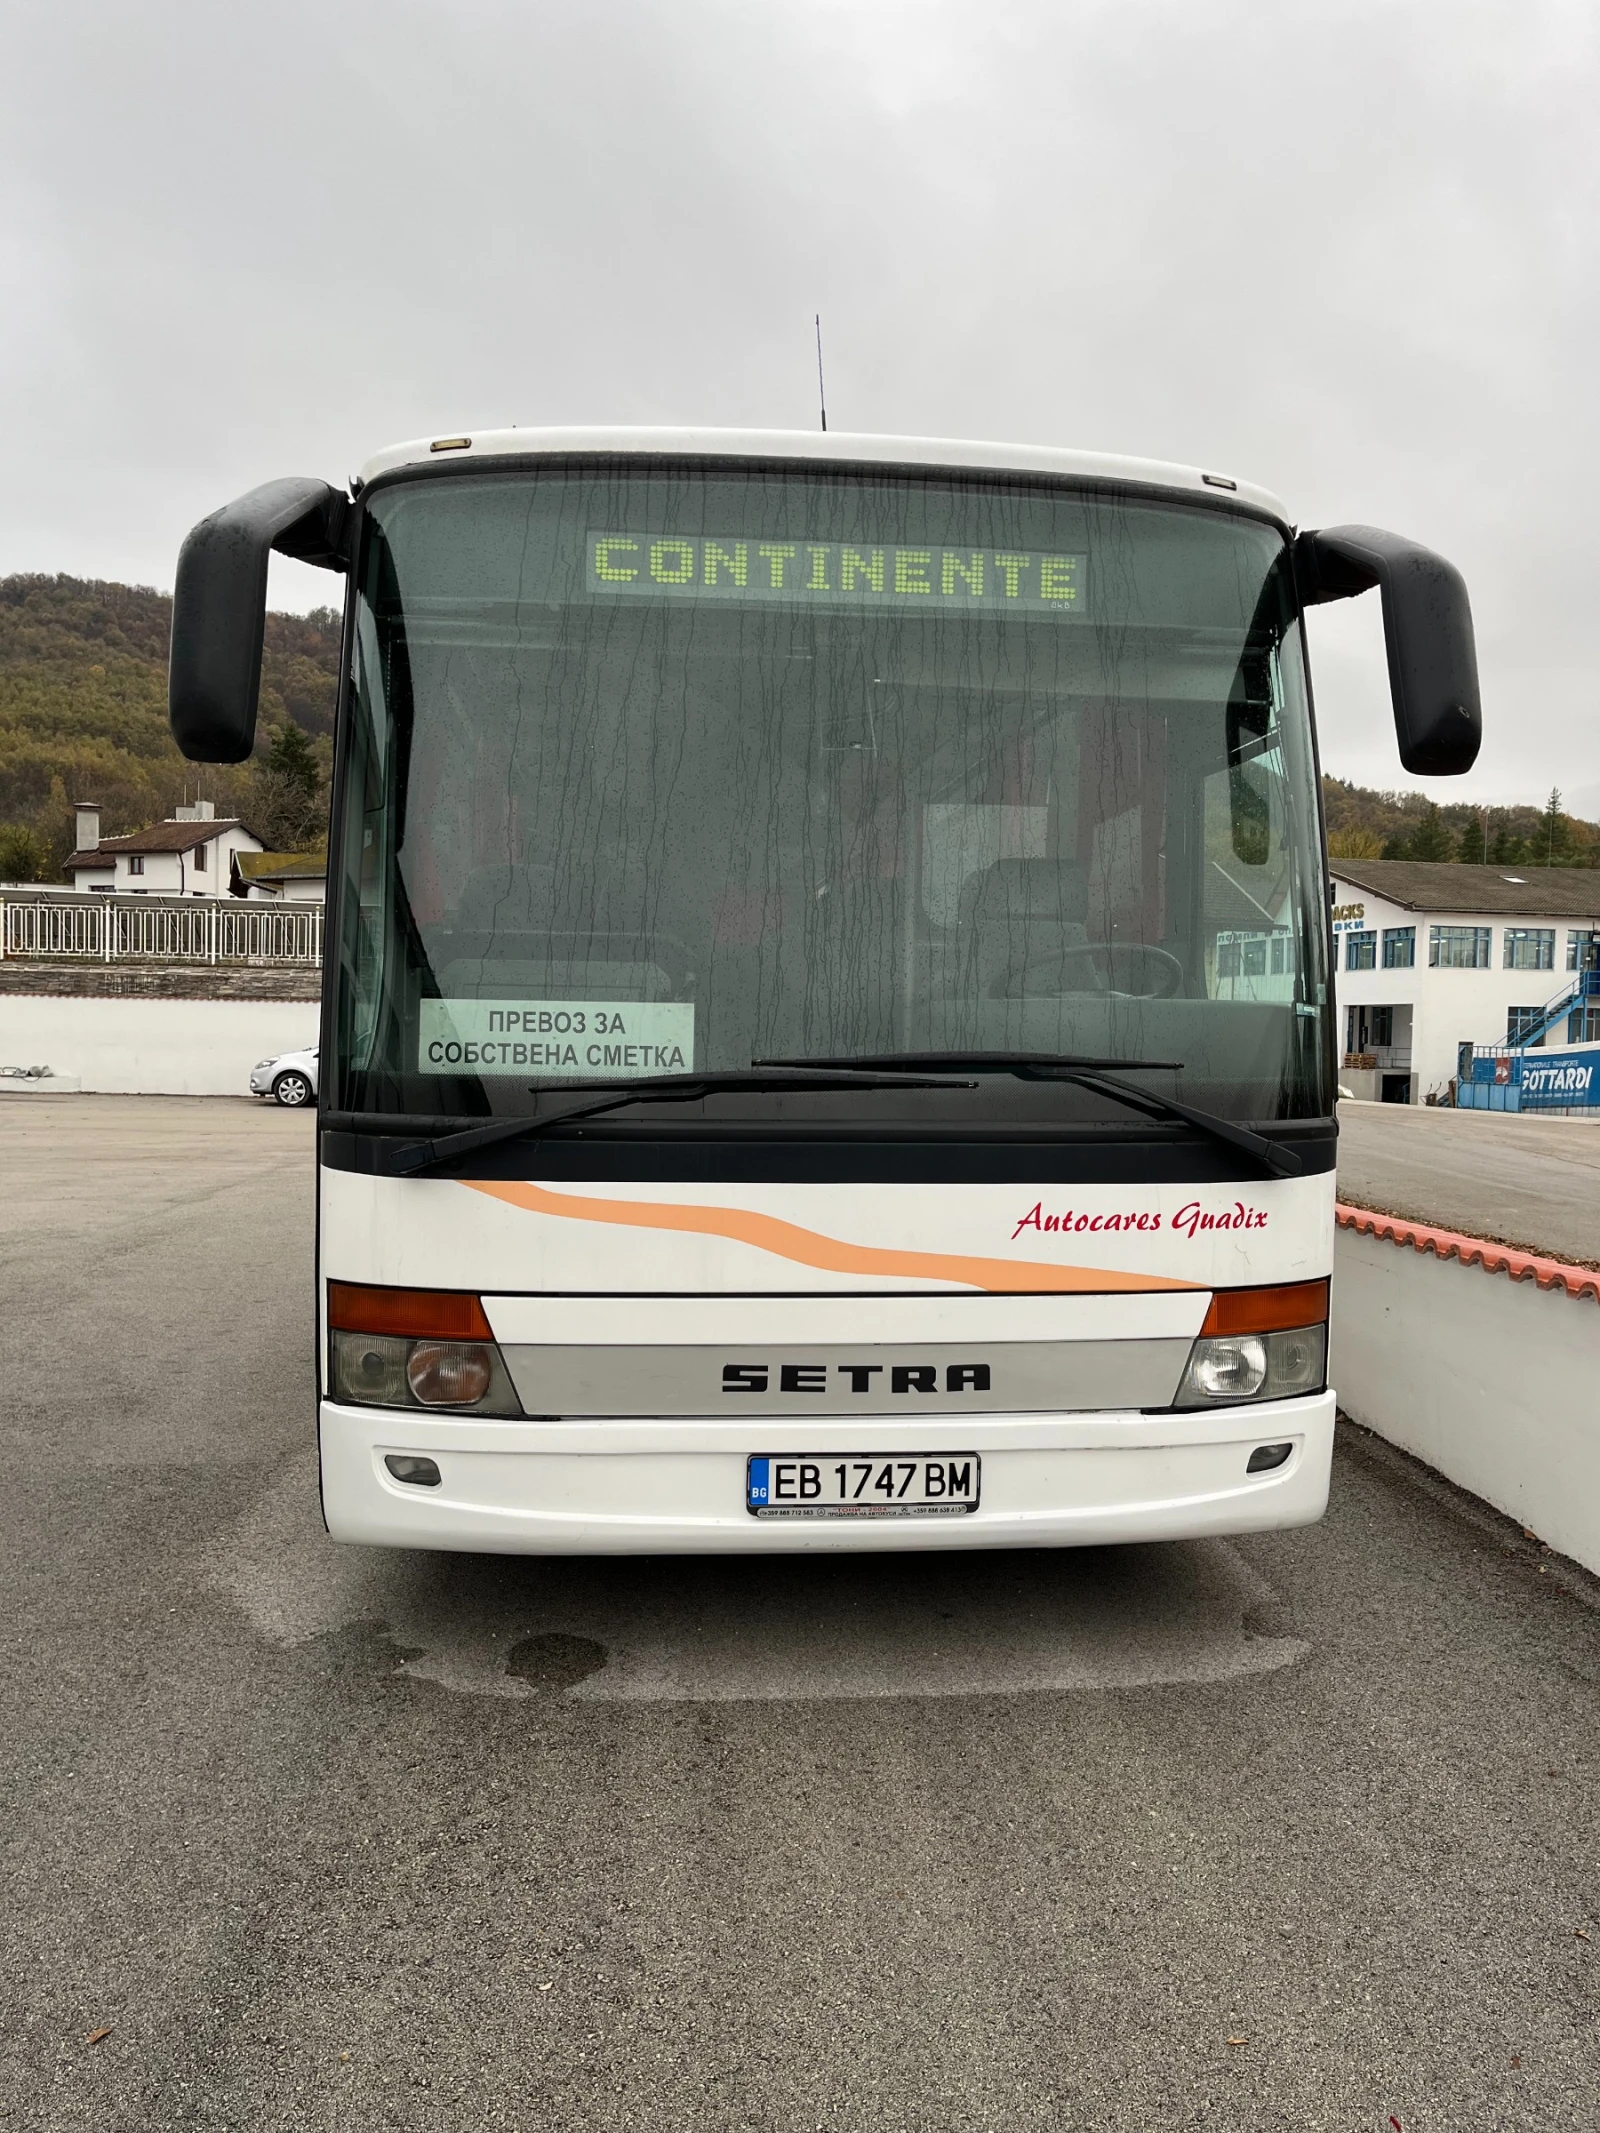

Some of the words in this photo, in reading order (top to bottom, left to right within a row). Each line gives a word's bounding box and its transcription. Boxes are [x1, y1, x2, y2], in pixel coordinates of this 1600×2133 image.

[595, 538, 1076, 599] CONTINENTE
[1332, 903, 1364, 921] ACKS
[1334, 921, 1364, 931] ВКИ
[489, 1010, 586, 1034] ПРЕВОЗ
[594, 1012, 626, 1034] ЗА
[428, 1041, 578, 1066] СОБСТВЕНА
[586, 1044, 685, 1068] СМЕТКА
[1522, 1066, 1593, 1091] GOTTARDI
[1010, 1201, 1161, 1240] Autocares
[1171, 1201, 1268, 1239] Guadix
[722, 1364, 991, 1393] SETRA
[752, 1487, 767, 1498] BG
[775, 1464, 821, 1499] EB
[834, 1463, 917, 1499] 1747
[925, 1462, 971, 1497] BM
